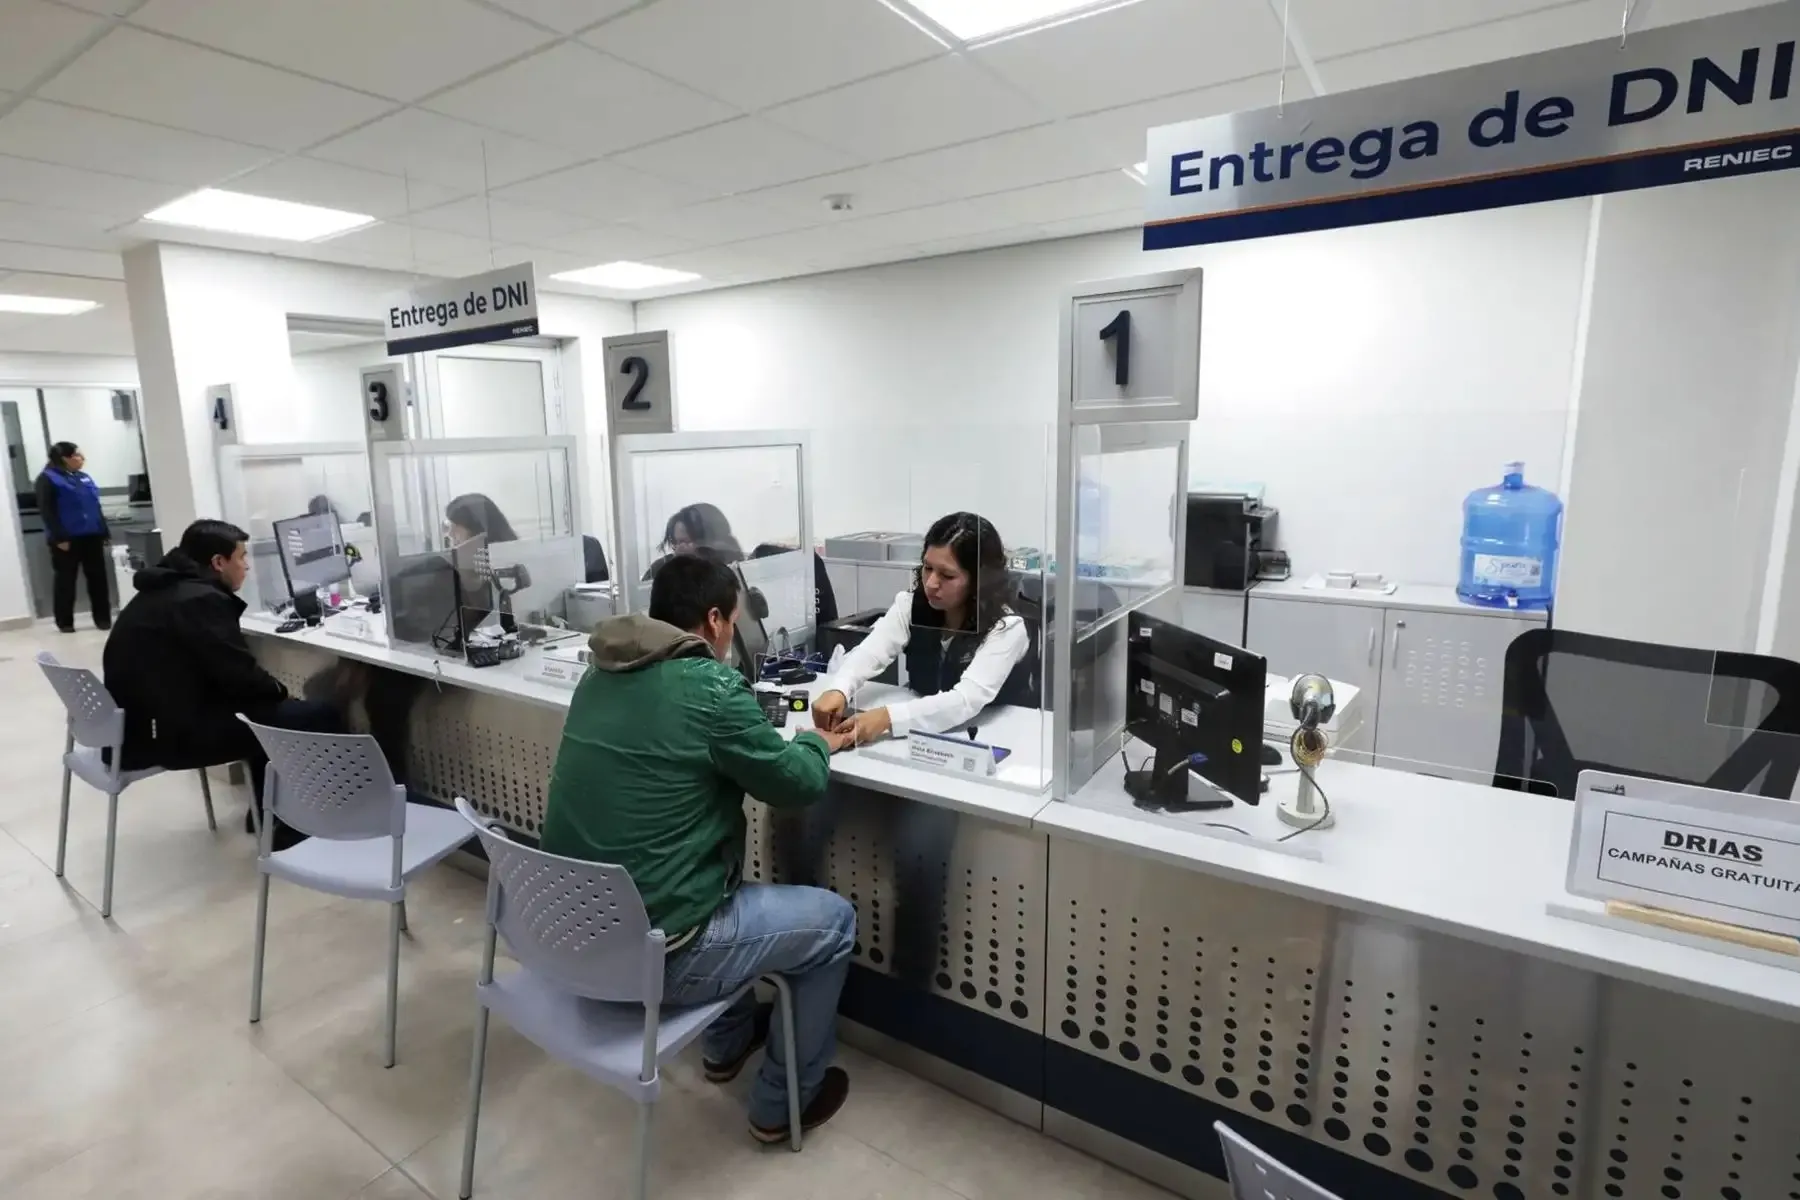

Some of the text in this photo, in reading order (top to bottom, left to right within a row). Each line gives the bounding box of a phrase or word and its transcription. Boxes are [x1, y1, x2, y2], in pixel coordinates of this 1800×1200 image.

[1170, 40, 1796, 196] Entrega de DNI
[1684, 145, 1793, 171] RENIEC
[390, 280, 529, 328] Entrega de DNI
[1099, 310, 1130, 386] 1
[368, 381, 389, 421] 3
[620, 356, 651, 410] 2
[213, 397, 228, 430] 4
[1607, 847, 1706, 874] CAMPAÑAS
[1663, 830, 1764, 863] DRIAS
